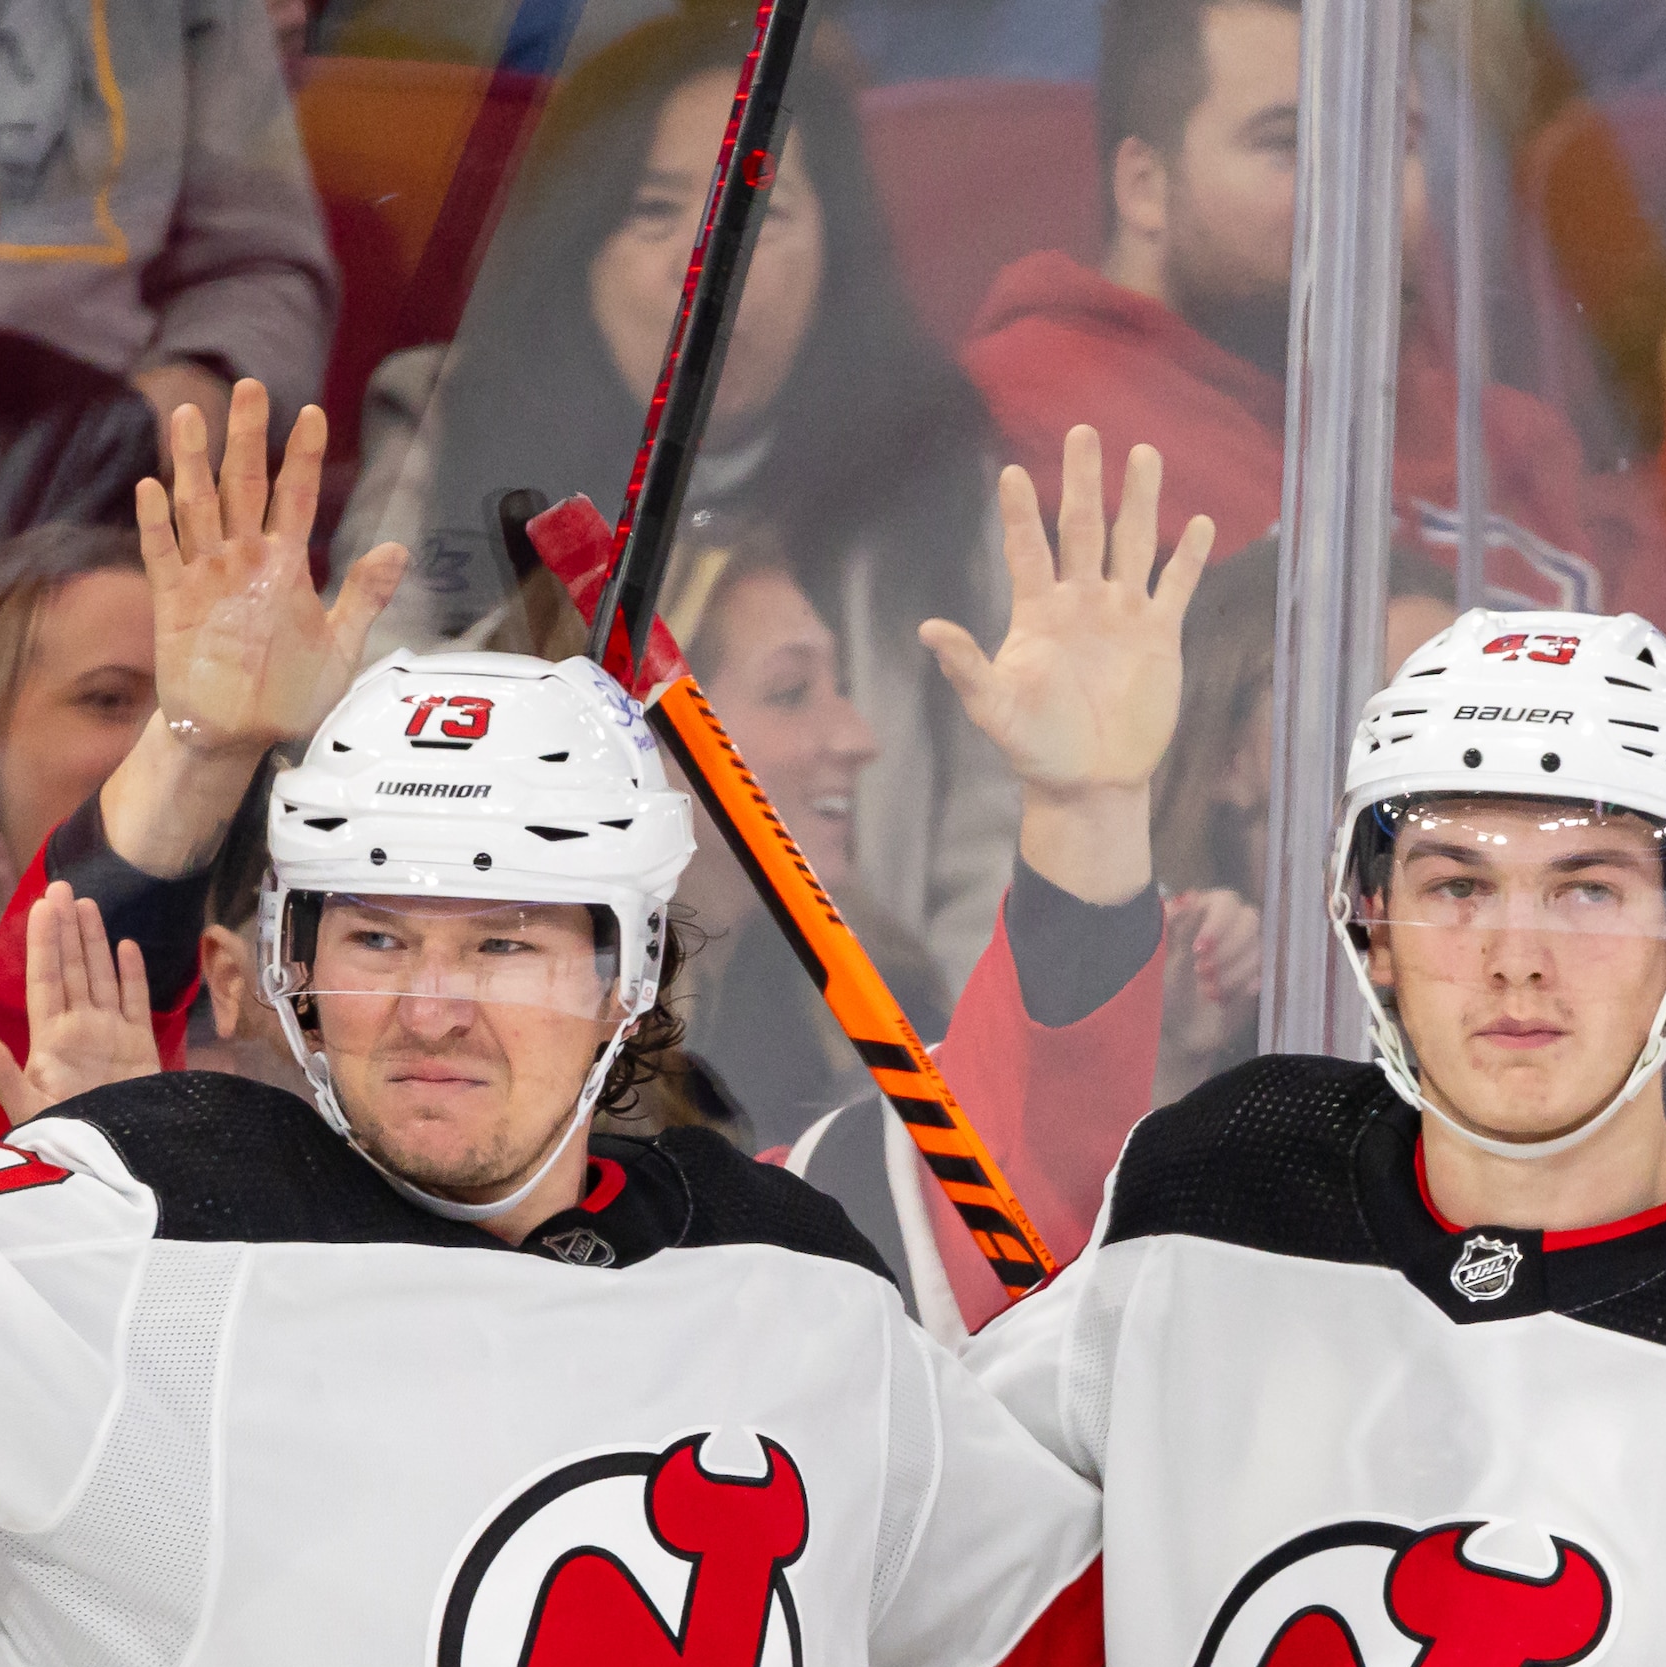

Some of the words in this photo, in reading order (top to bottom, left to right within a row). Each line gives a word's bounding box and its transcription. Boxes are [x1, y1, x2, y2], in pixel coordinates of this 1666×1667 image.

[1481, 634, 1582, 666] 43
[399, 695, 496, 740] 73
[1453, 705, 1575, 726] BAUER
[375, 781, 493, 799] WARRIOR
[1462, 1257, 1508, 1284] NHL
